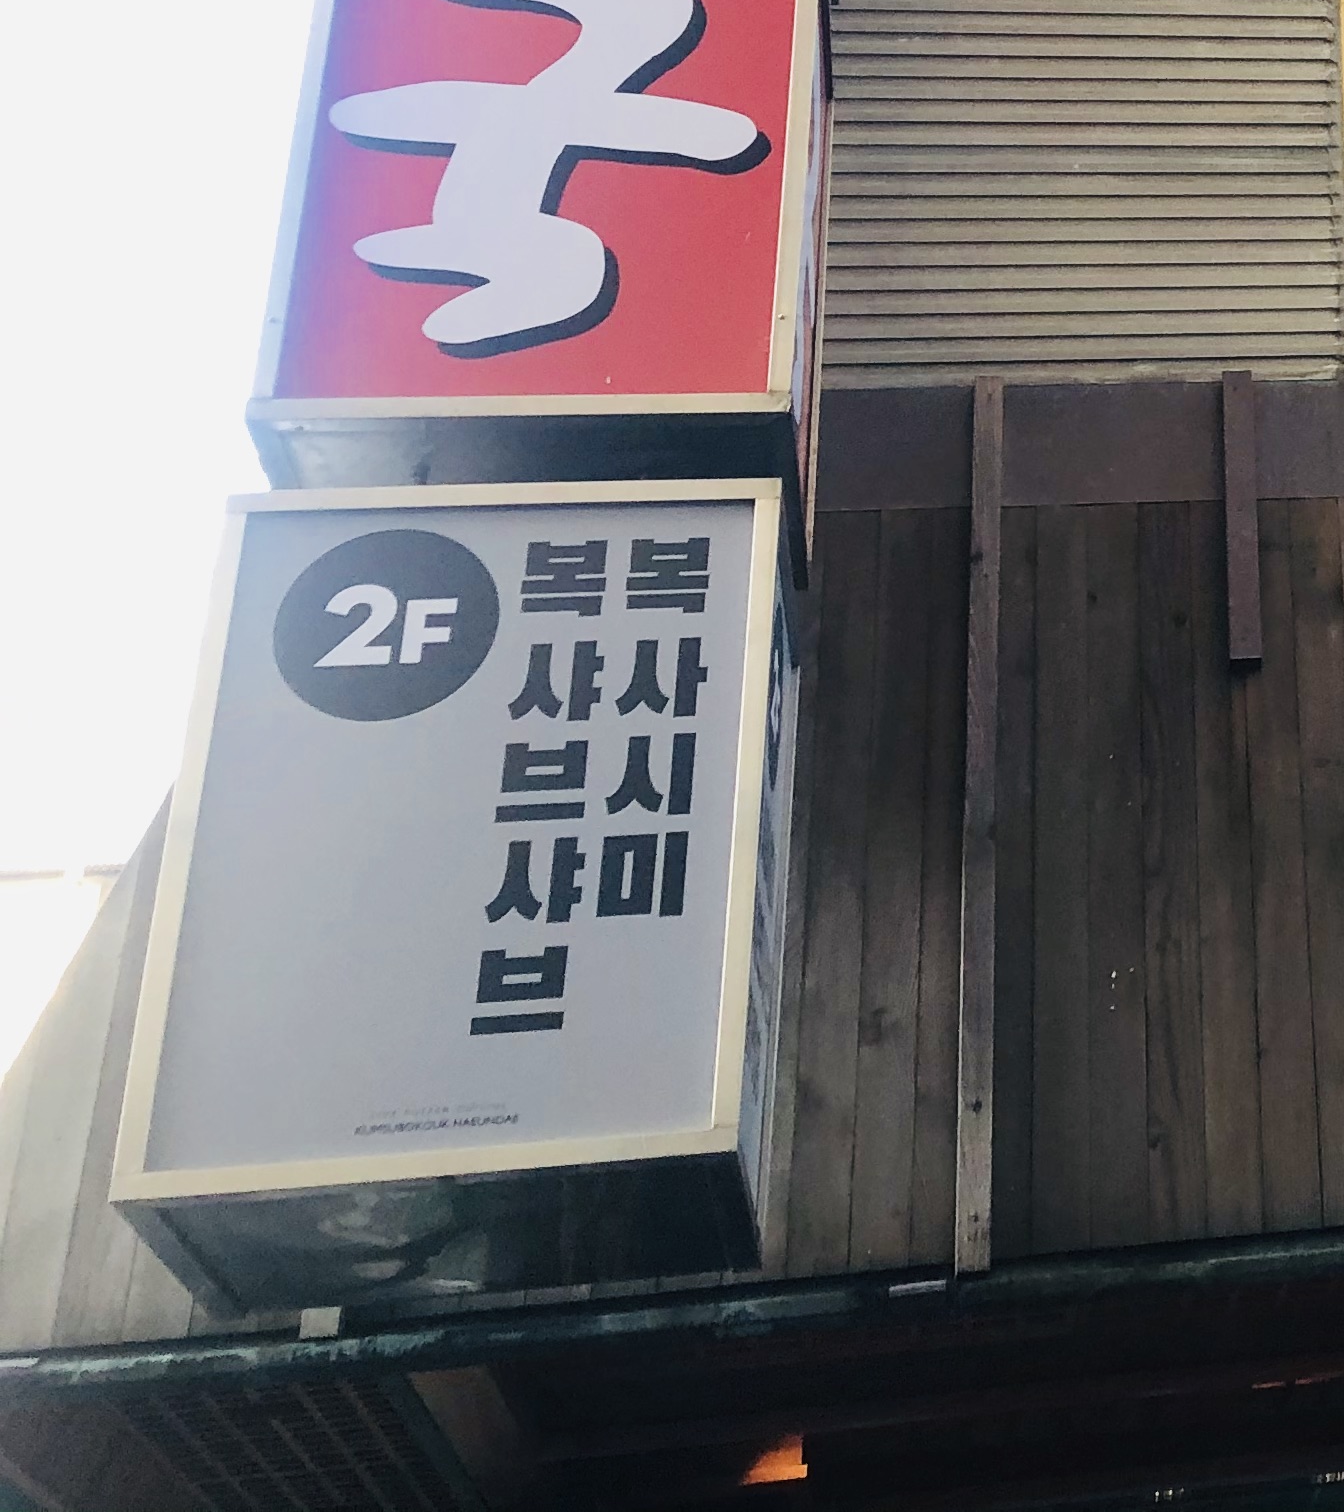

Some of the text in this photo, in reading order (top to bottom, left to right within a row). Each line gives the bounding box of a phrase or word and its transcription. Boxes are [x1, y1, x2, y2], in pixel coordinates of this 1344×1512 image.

[312, 583, 459, 669] 2F
[468, 538, 608, 1037] 복샤브샤브
[595, 536, 711, 919] 복사시미
